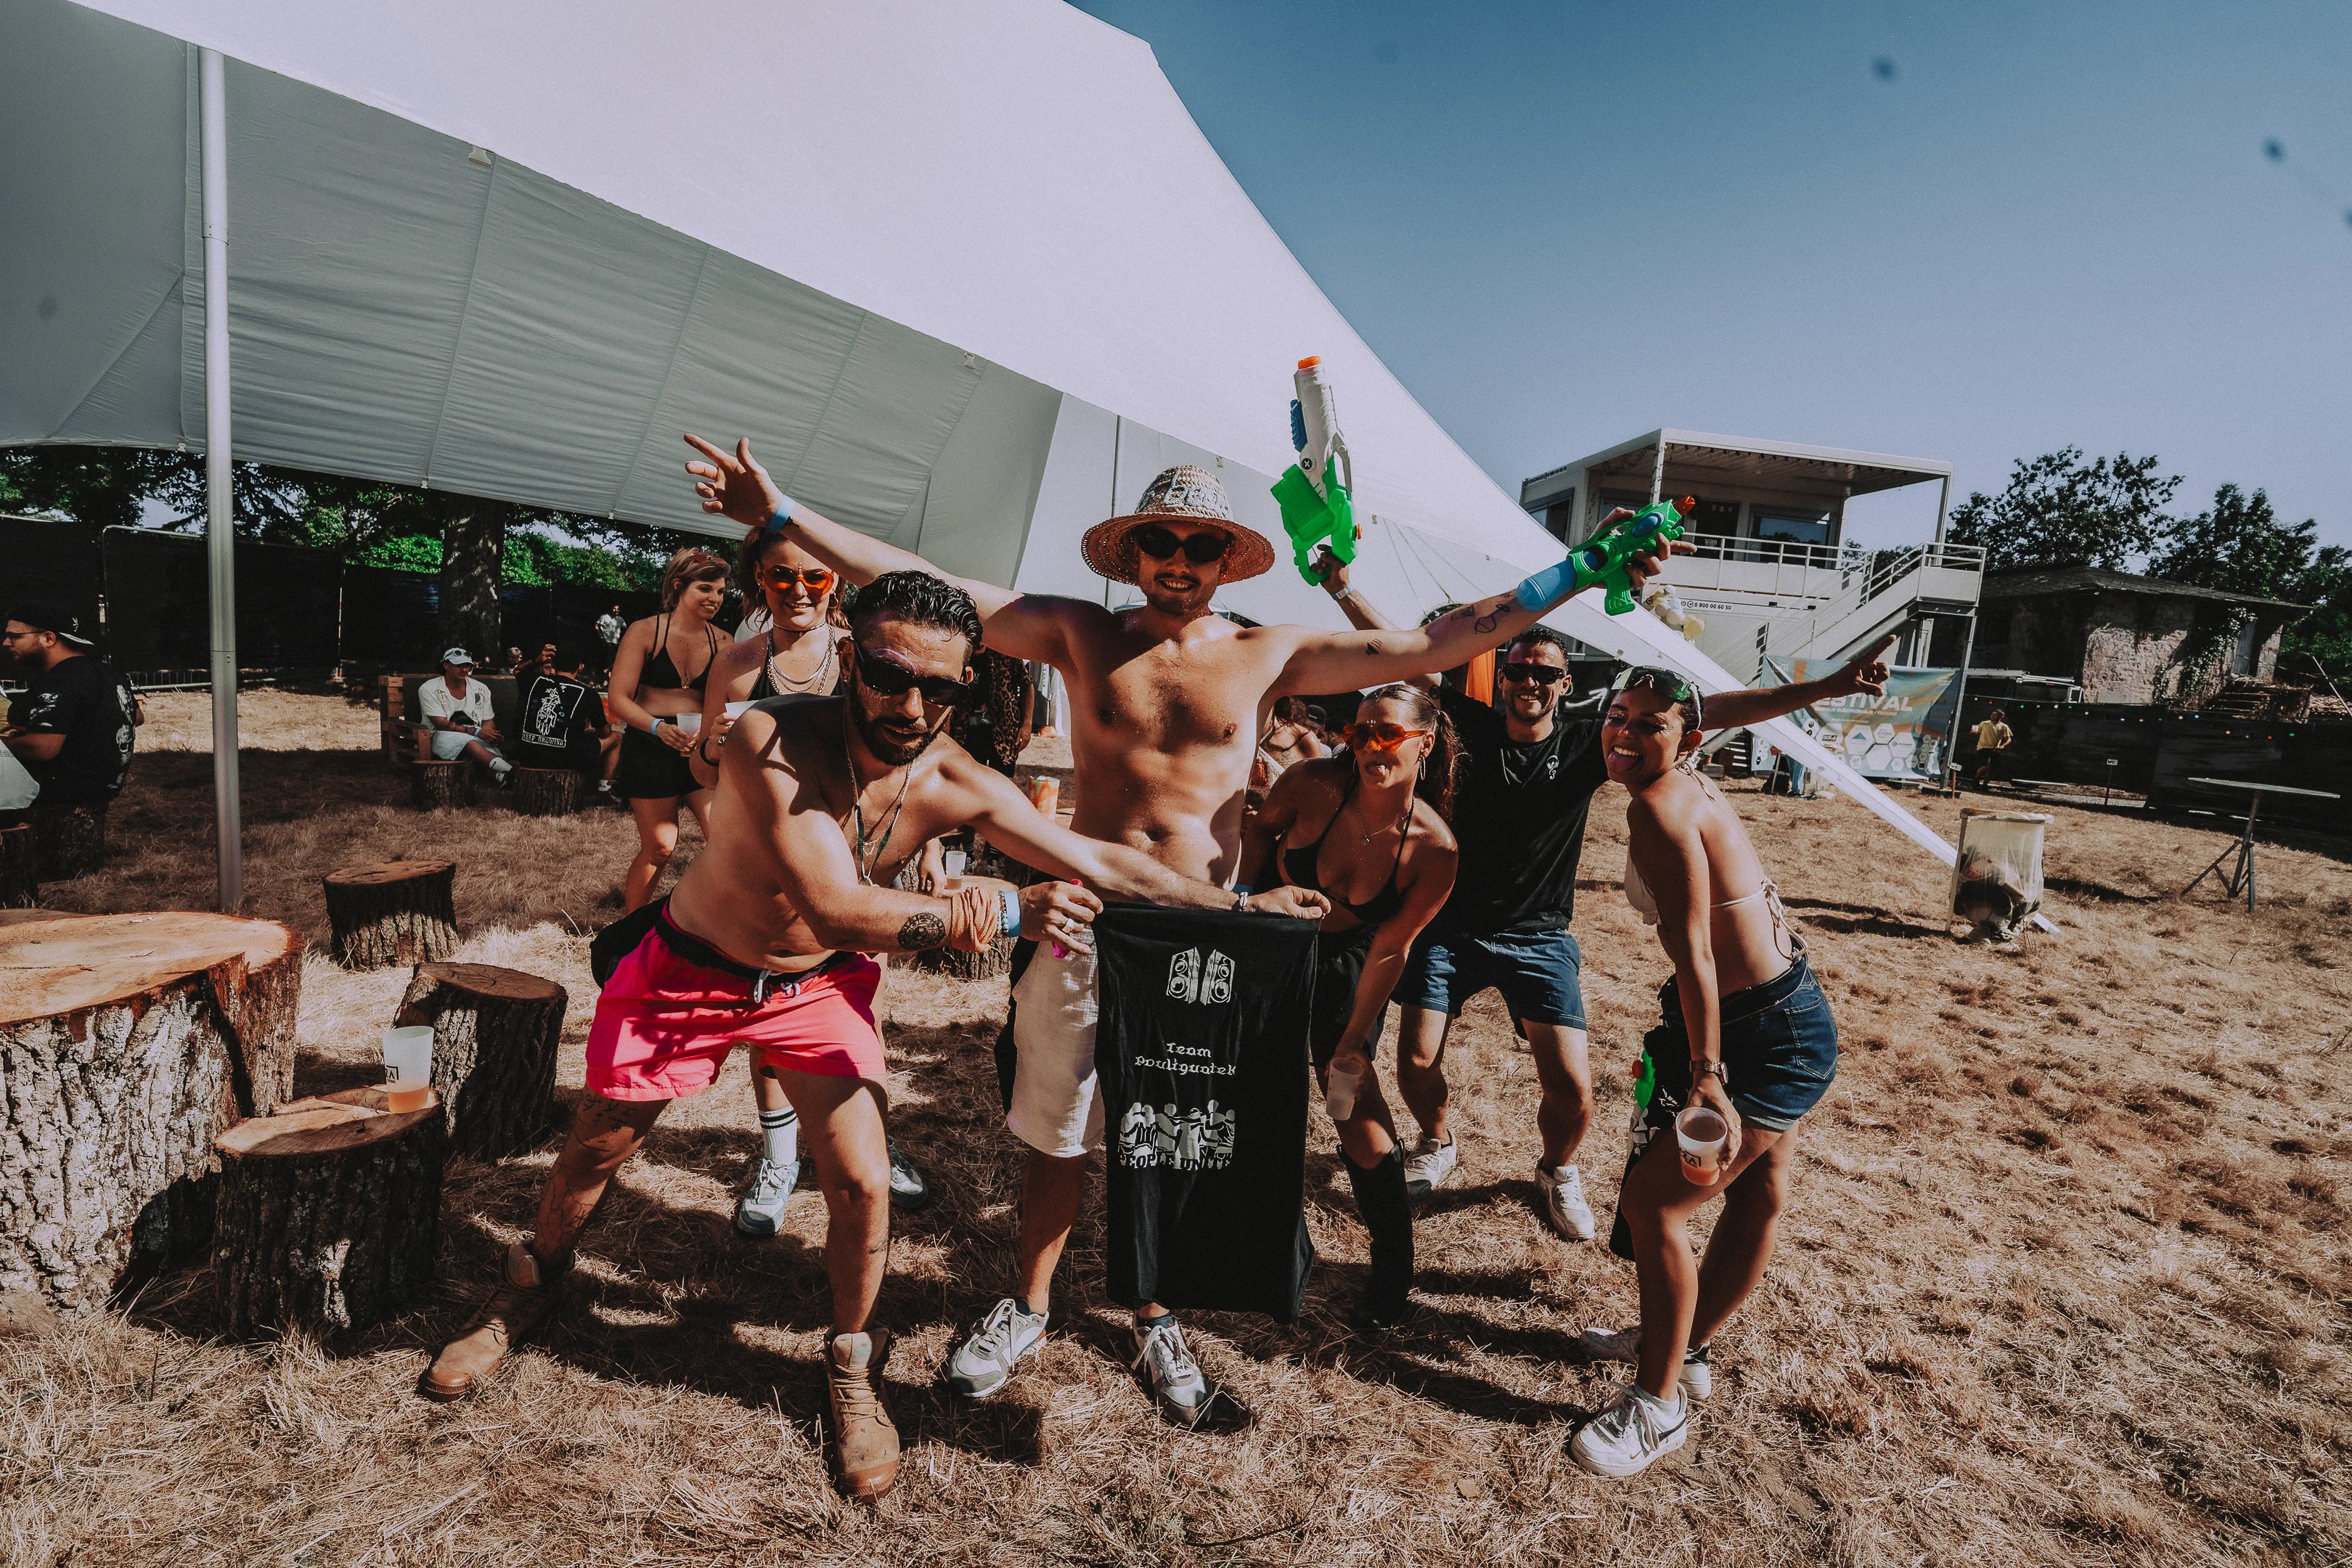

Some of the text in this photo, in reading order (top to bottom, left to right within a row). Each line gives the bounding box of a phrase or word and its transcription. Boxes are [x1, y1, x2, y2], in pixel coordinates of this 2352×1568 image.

[1704, 539, 1718, 547] VIP
[1815, 692, 1913, 711] ESTIVAL
[538, 736, 563, 746] GROWING
[1167, 1042, 1212, 1058] Team
